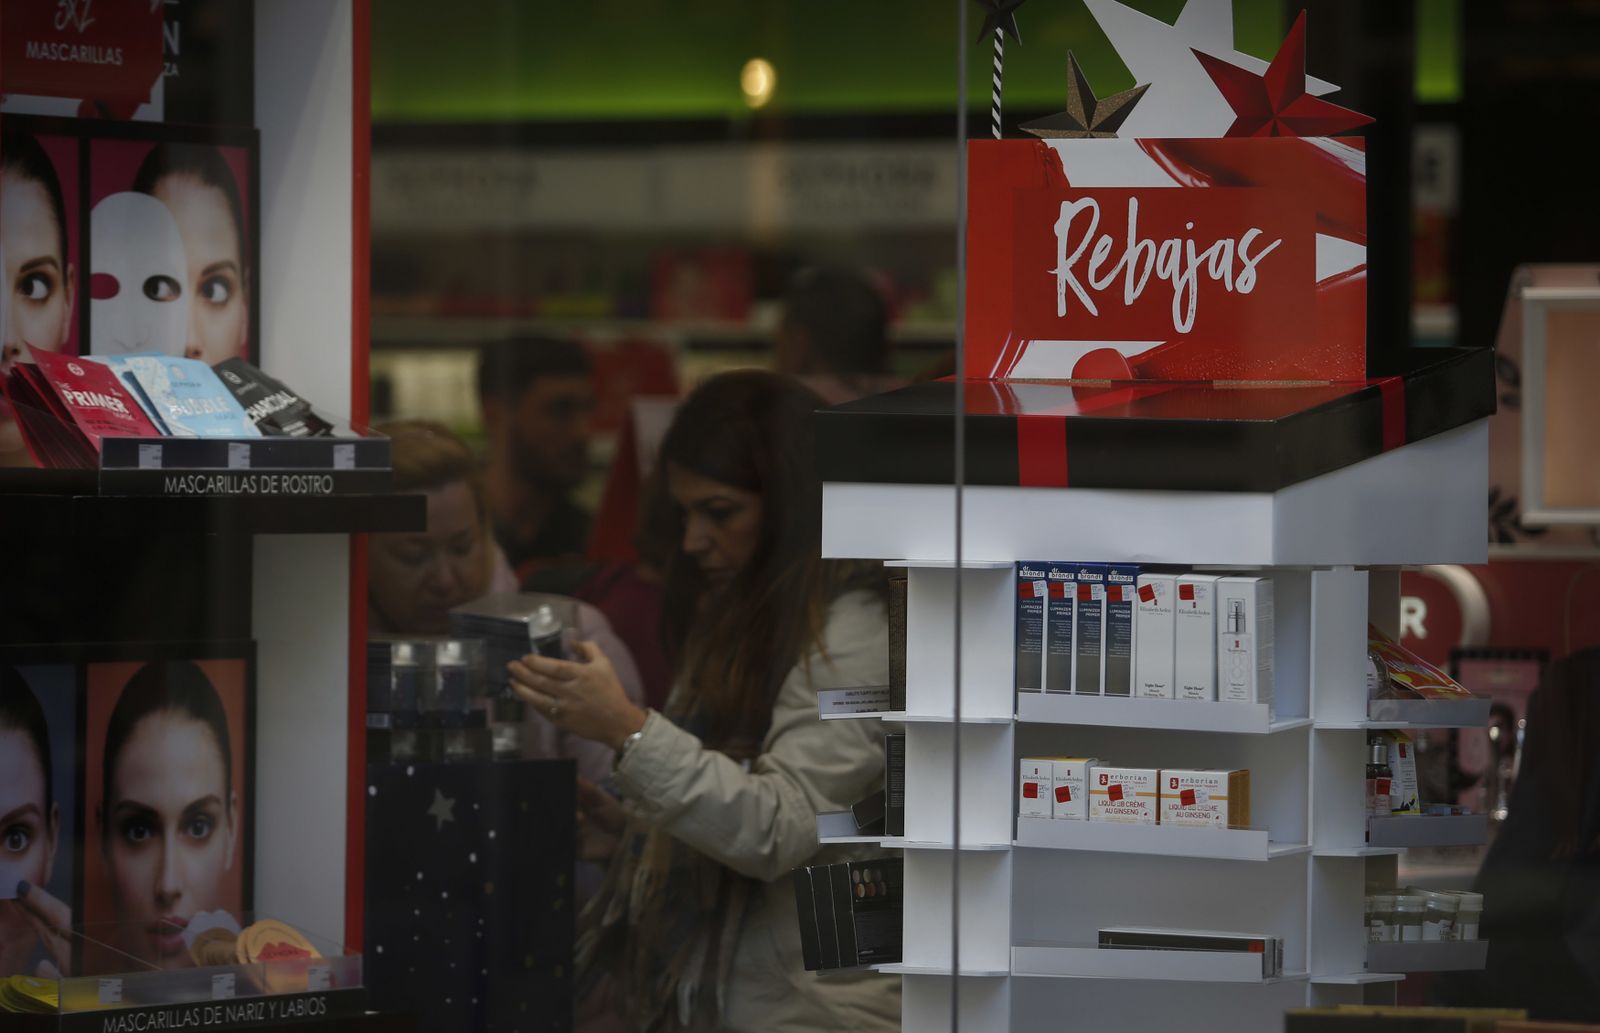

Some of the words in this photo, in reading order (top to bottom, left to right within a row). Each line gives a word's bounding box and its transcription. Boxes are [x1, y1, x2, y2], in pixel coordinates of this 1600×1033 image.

[26, 41, 123, 65] MASCARILLAS
[1047, 197, 1282, 333] Rebajas
[62, 389, 129, 414] PRIMER
[164, 475, 257, 494] MASCARILLAS
[260, 475, 279, 494] DE
[281, 475, 333, 494] ROSTRO
[1114, 808, 1139, 816] GINSENG
[103, 1008, 200, 1033] MASCARILLAS
[203, 1005, 223, 1025] DE
[225, 1002, 265, 1023] NARIZ
[268, 1001, 277, 1018] Y
[280, 996, 326, 1018] LABIOS
